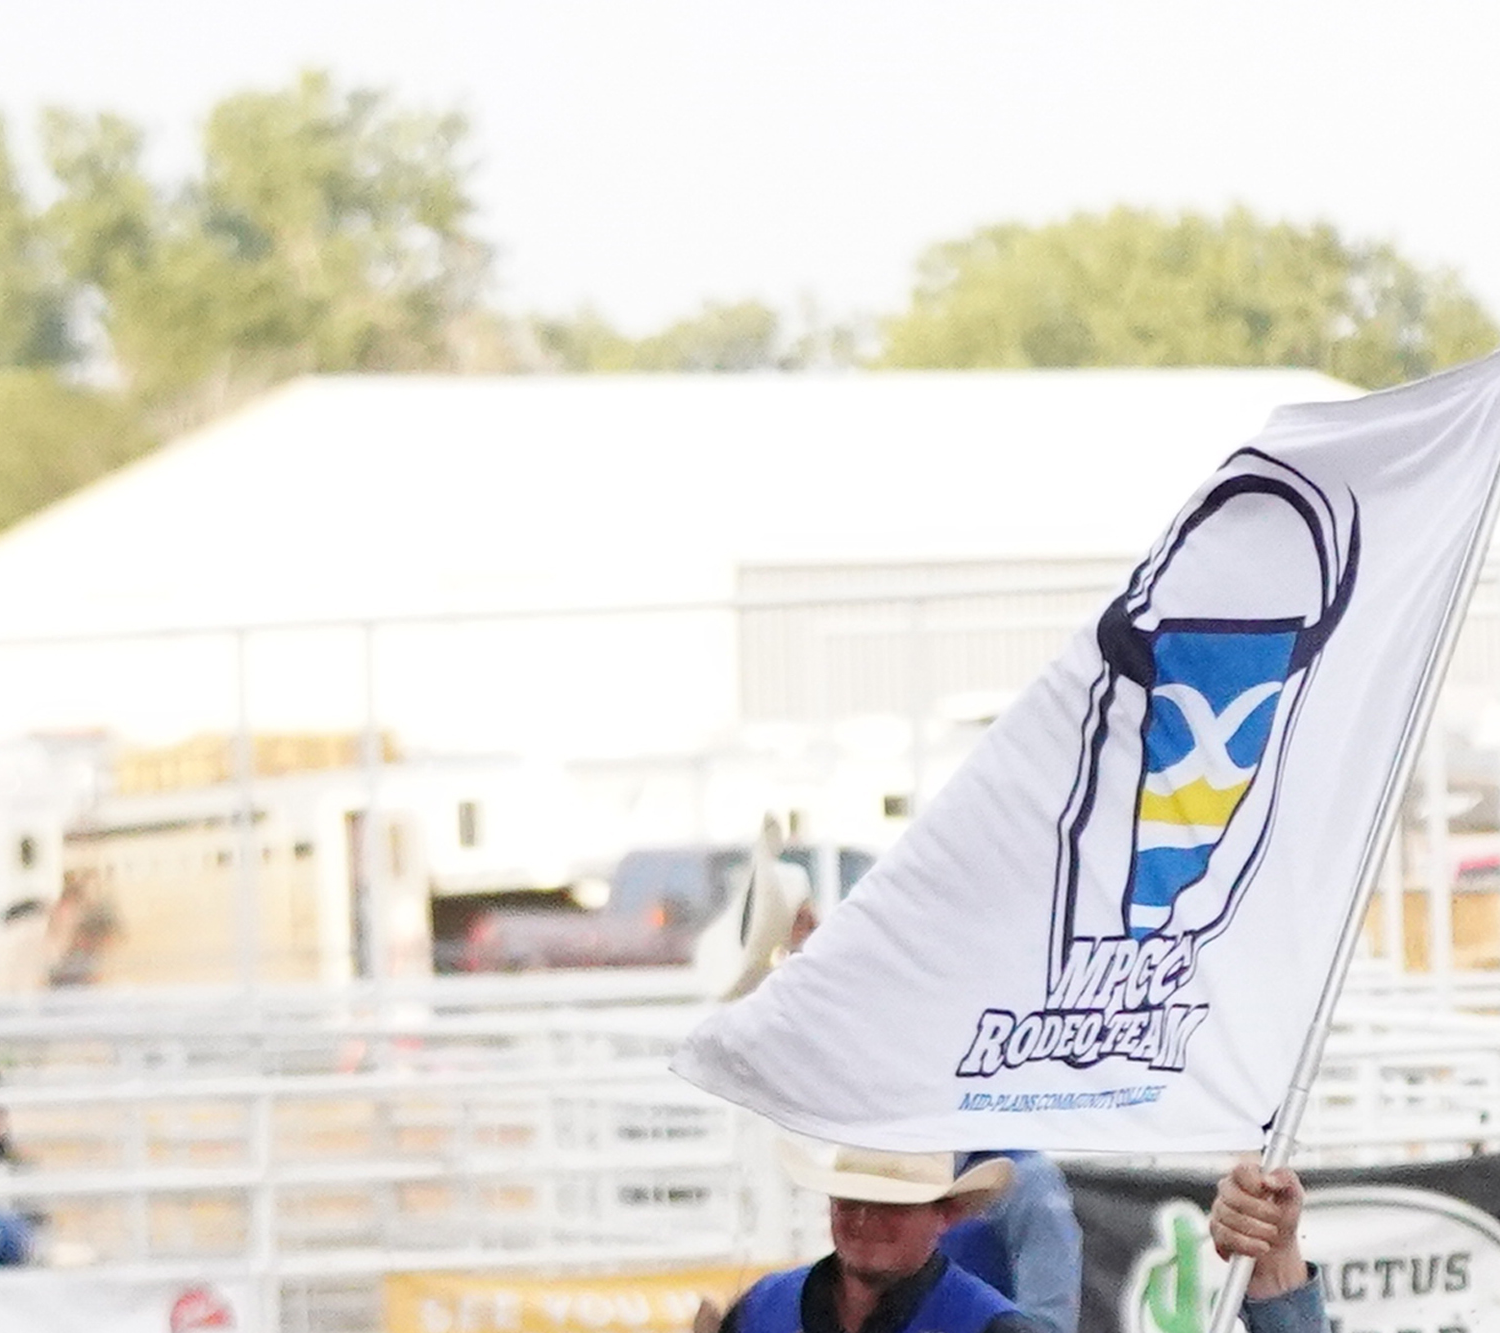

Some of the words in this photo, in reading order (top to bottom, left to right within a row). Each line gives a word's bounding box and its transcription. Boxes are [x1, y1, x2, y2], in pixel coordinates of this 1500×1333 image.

[1045, 935, 1193, 1013] MPCC
[956, 1007, 1106, 1078] RODEO
[1097, 1003, 1210, 1073] TEAM
[1322, 1252, 1471, 1301] CTUS
